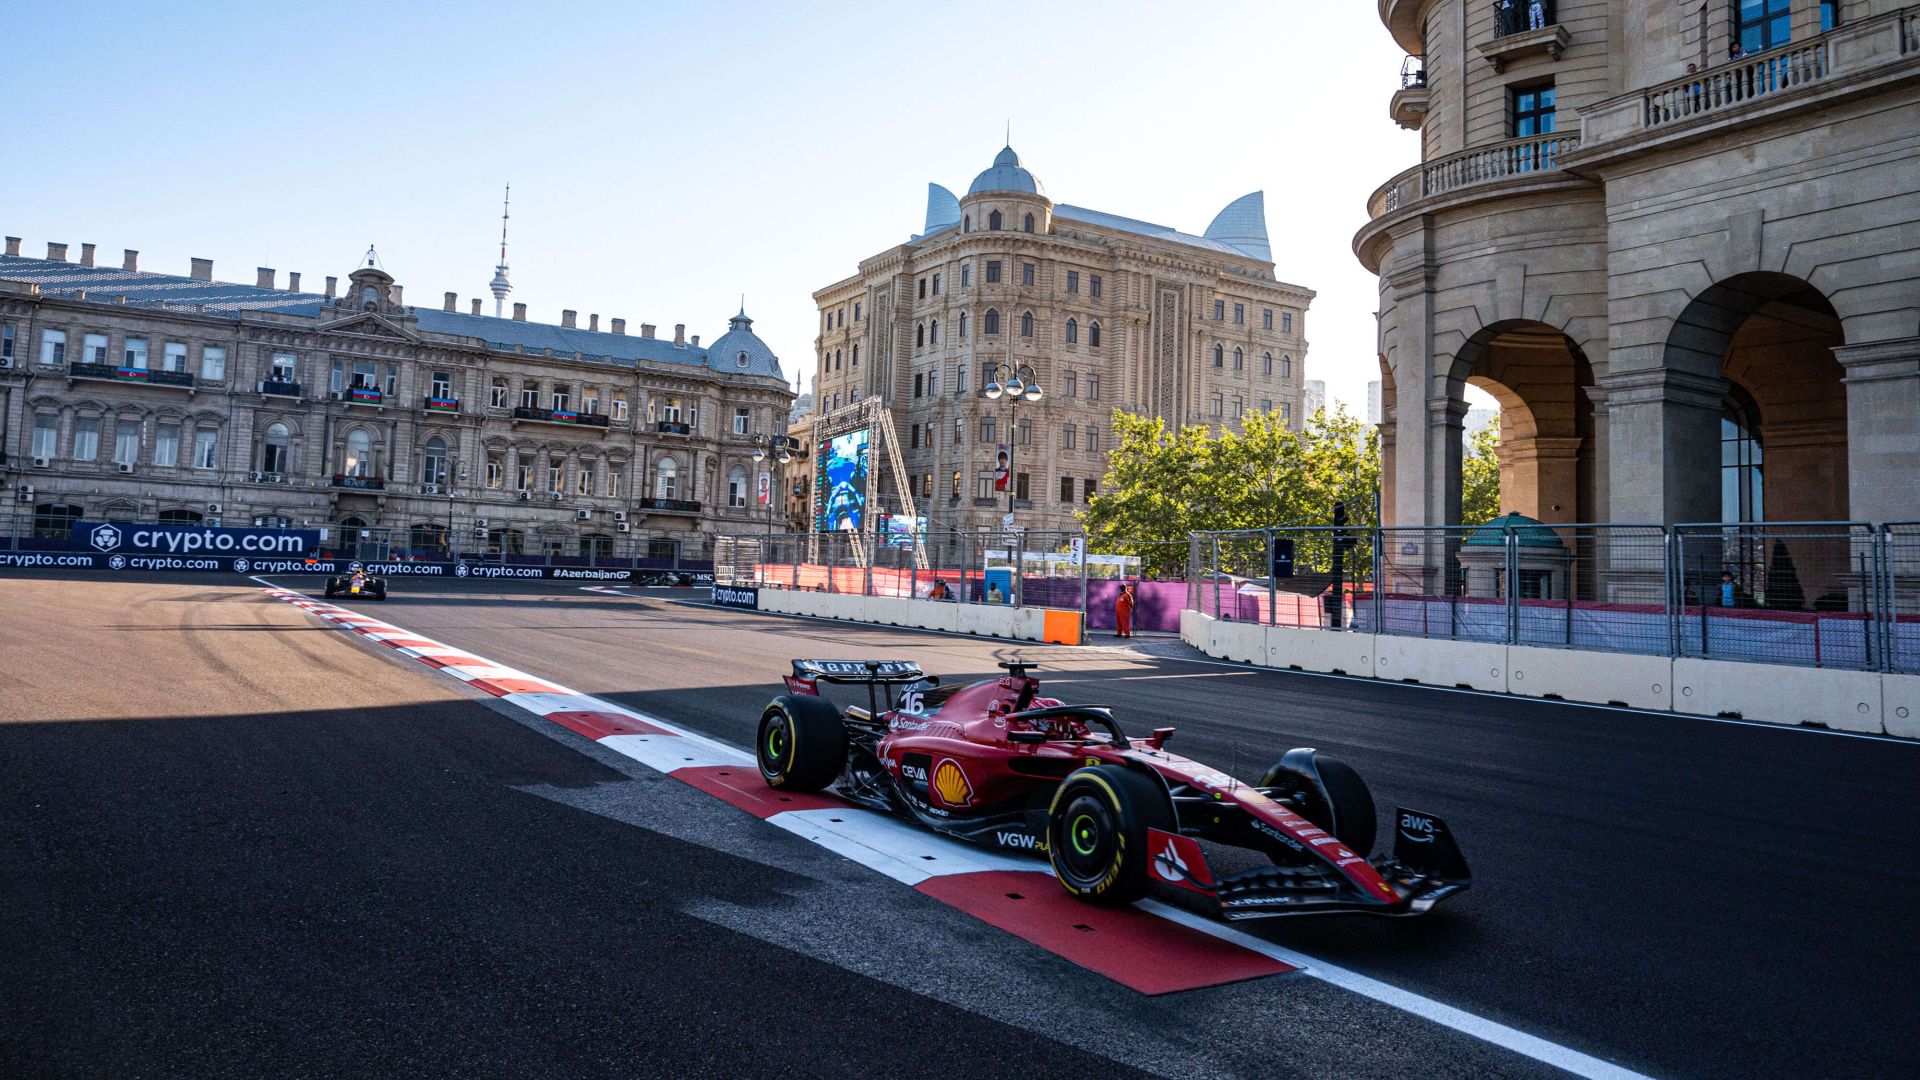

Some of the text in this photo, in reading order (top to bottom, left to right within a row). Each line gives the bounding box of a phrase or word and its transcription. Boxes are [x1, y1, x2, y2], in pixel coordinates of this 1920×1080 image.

[132, 529, 304, 553] crypto.com
[0, 554, 93, 567] crypto.com
[130, 557, 219, 570] crypto.com
[253, 560, 335, 573] crypto.com
[366, 563, 443, 576] crypto.com
[472, 566, 543, 577] crypto.com
[696, 573, 714, 581] MSC
[717, 588, 755, 605] crypto.com
[900, 691, 924, 716] 16
[1401, 813, 1434, 833] aws
[997, 831, 1050, 851] VGW PLA
